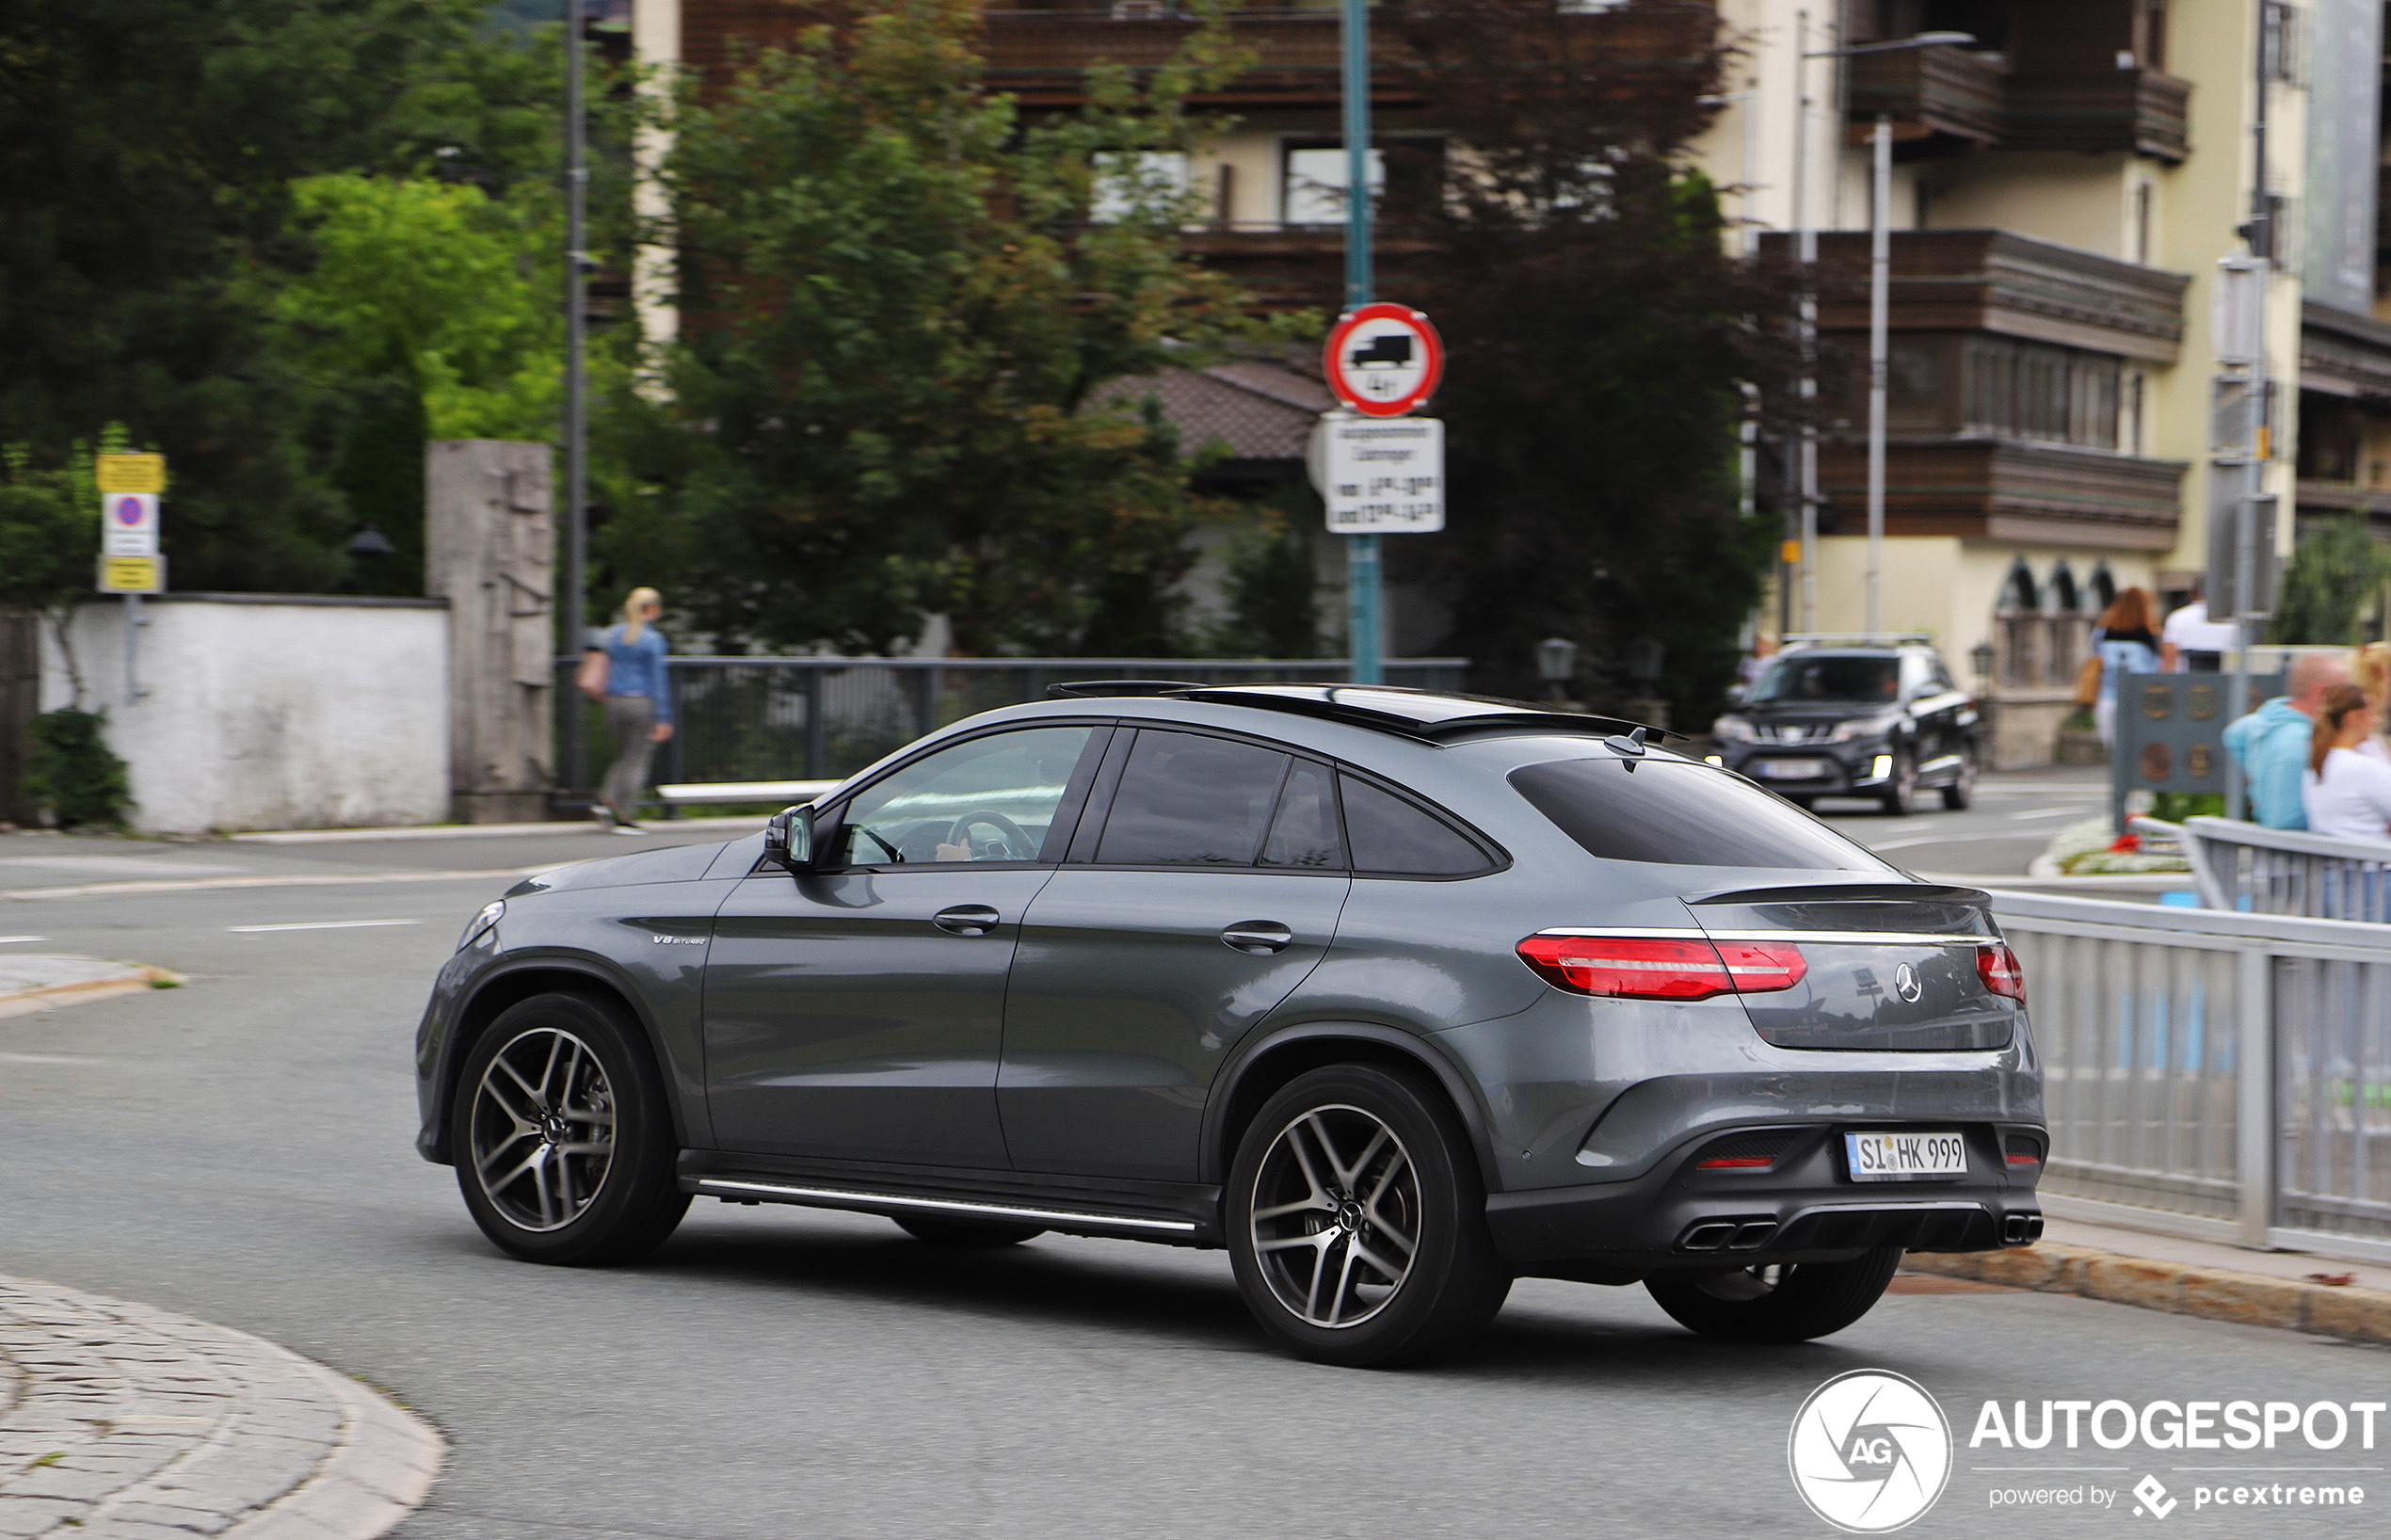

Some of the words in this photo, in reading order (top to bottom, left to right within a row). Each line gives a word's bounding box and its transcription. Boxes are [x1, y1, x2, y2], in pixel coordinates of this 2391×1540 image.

[653, 935, 674, 945] V8
[1861, 1138, 1886, 1169] SI
[1897, 1138, 1925, 1169] HK
[1928, 1138, 1962, 1169] 999
